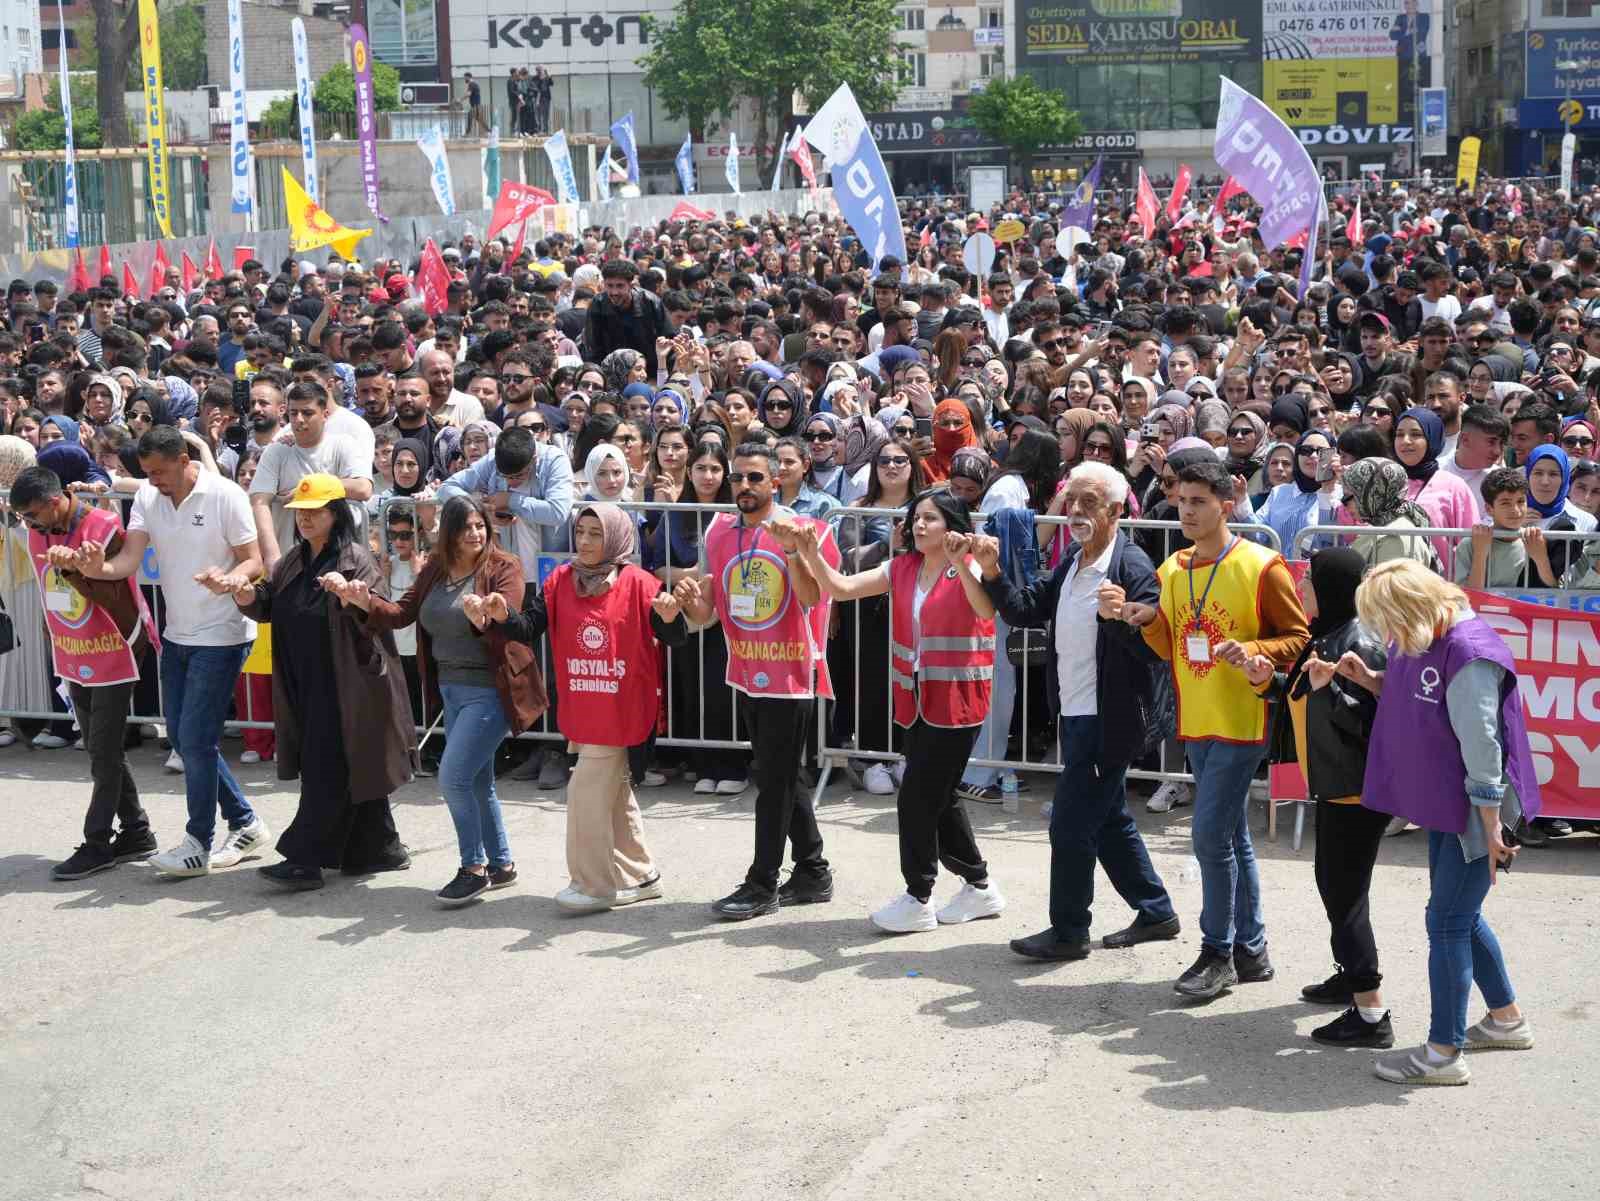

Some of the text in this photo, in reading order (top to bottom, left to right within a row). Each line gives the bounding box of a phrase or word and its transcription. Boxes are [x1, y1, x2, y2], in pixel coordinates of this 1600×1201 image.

[1026, 23, 1083, 44] SEDA
[1089, 20, 1177, 45] KARASU
[1279, 17, 1390, 31] 0476 476 01 76
[1095, 135, 1135, 147] GOLD
[1300, 124, 1414, 144] DÖVİZ
[567, 657, 626, 680] OSYAL-İŞ
